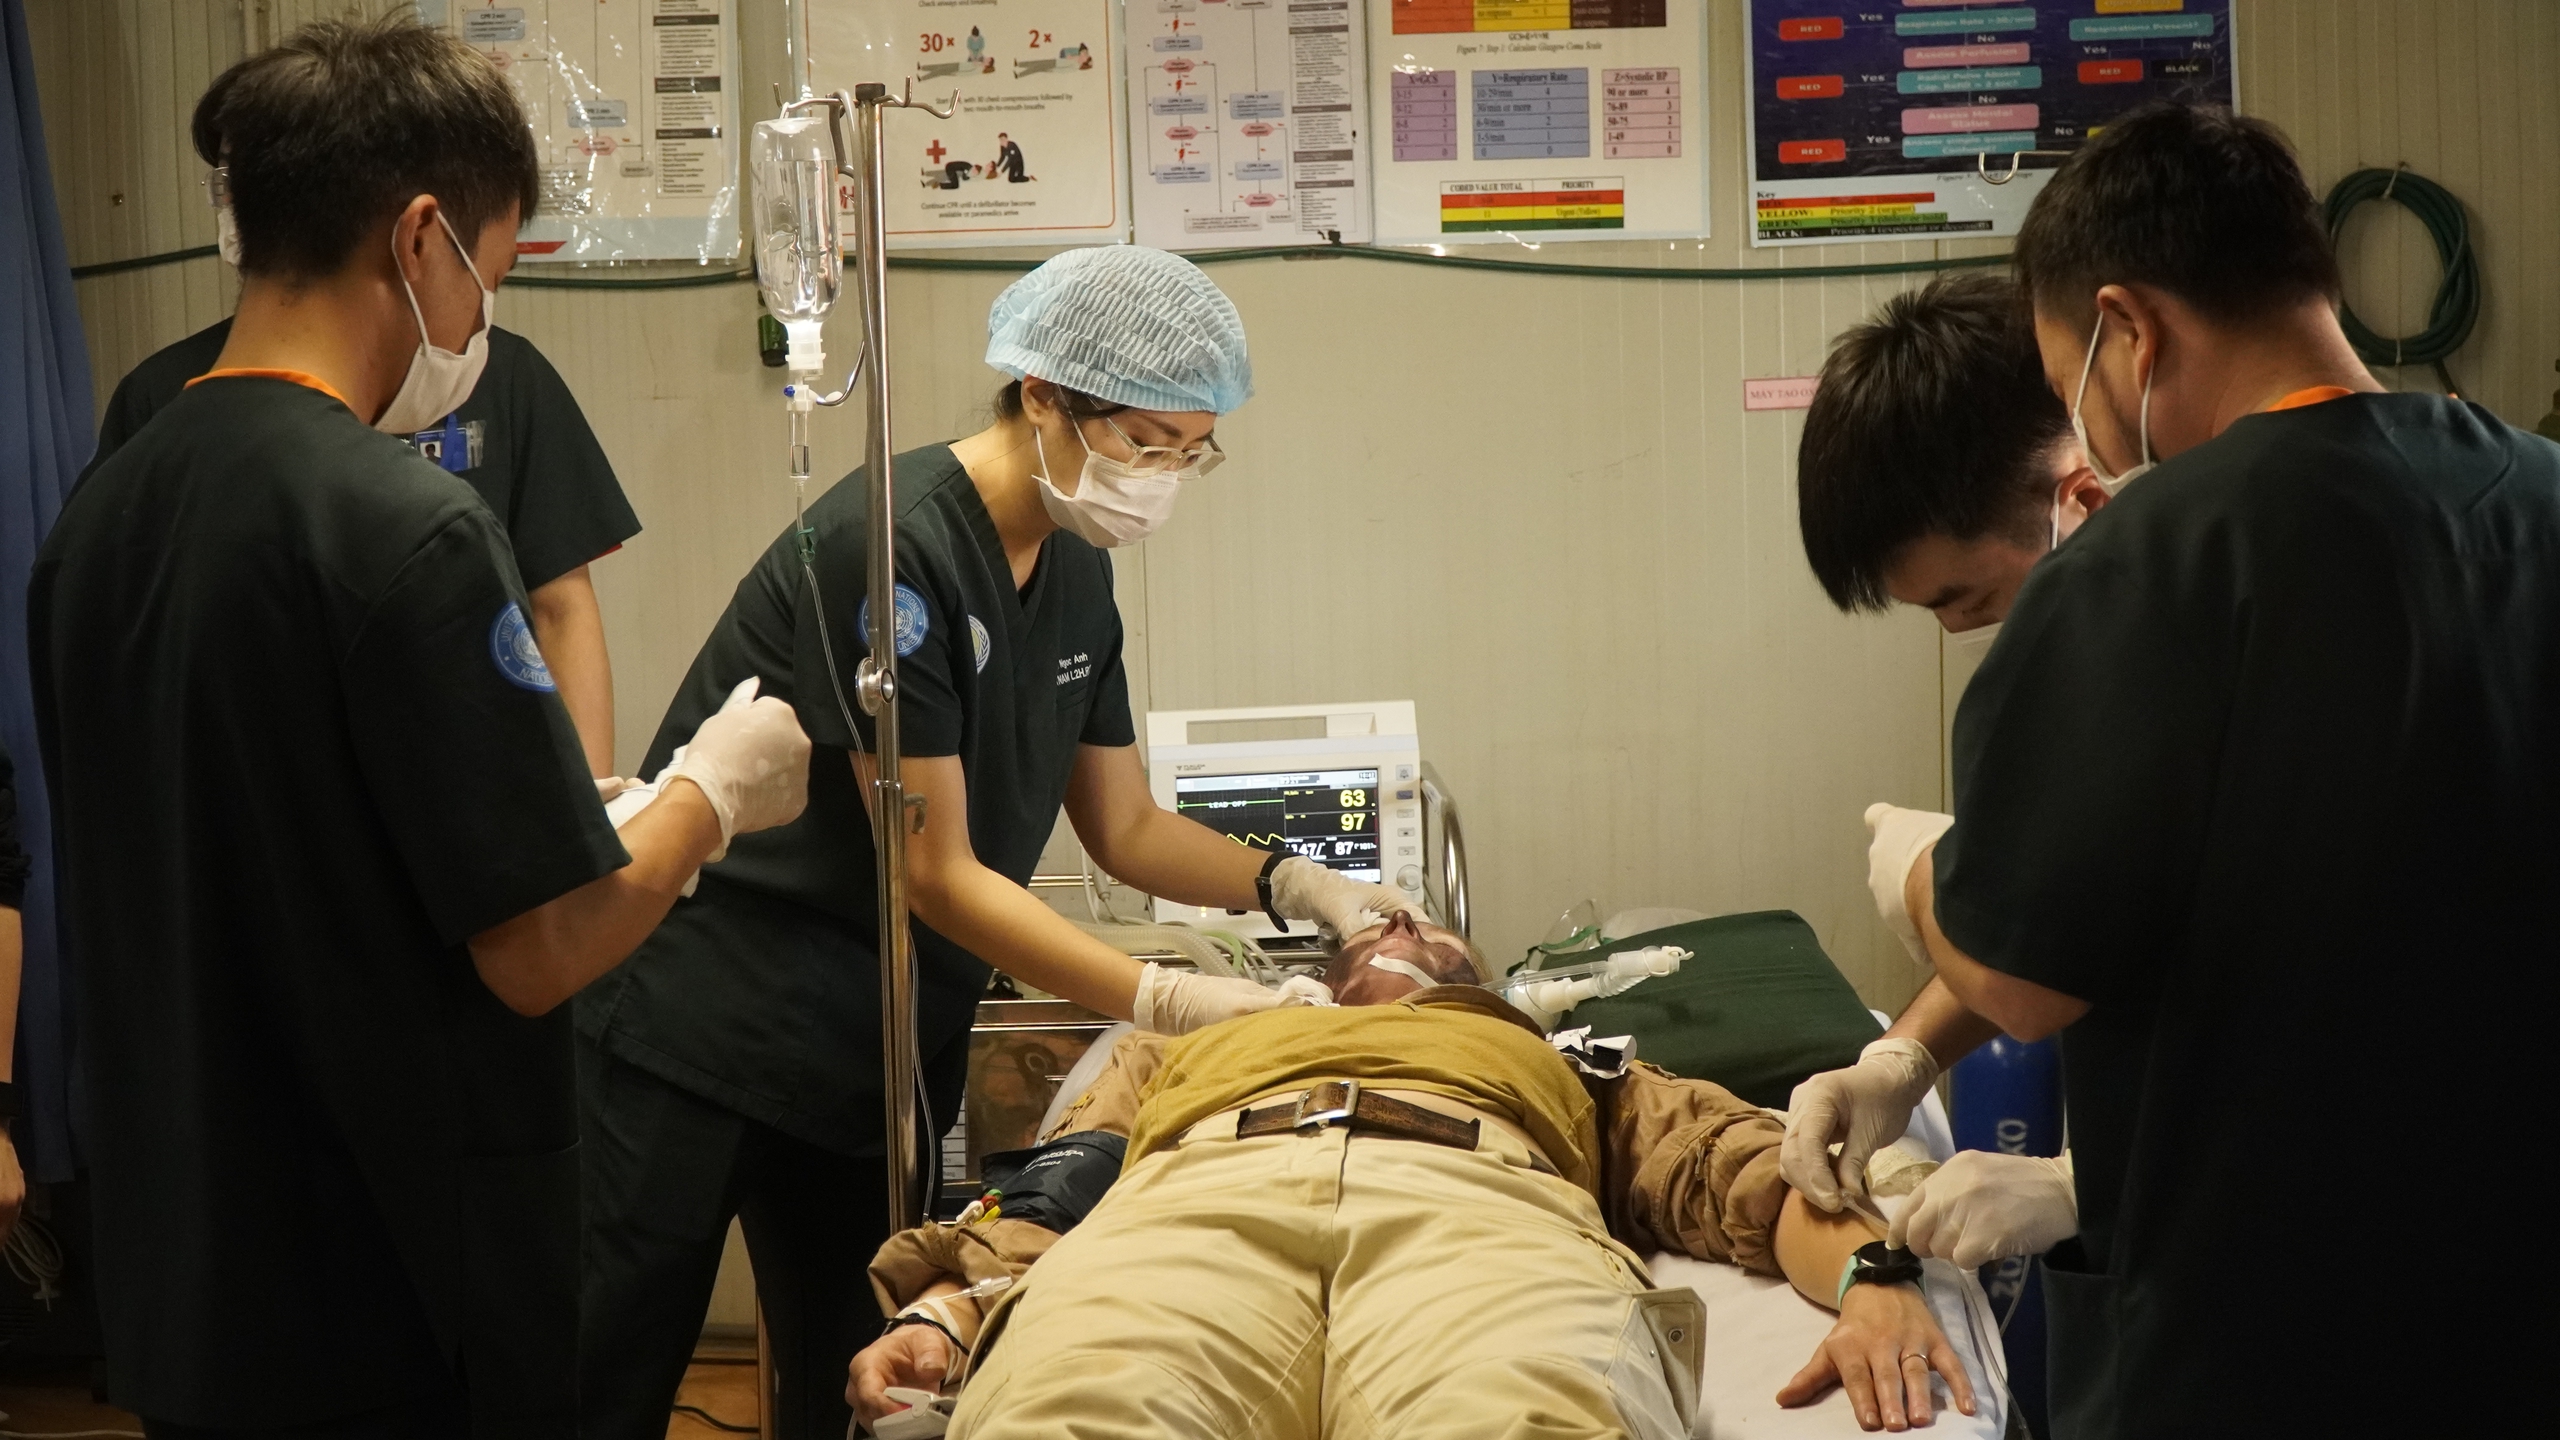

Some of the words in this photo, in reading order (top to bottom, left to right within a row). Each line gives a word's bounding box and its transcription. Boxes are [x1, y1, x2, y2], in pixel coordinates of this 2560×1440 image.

[1860, 14, 1884, 22] Yes
[1896, 20, 1957, 30] Respiration
[920, 33, 943, 52] 30
[1028, 29, 1040, 48] 2
[1977, 34, 1996, 42] No
[2082, 46, 2108, 54] Yes
[2192, 42, 2211, 50] No
[1916, 51, 1958, 59] Assess
[1960, 48, 2017, 57] Perfusion
[2165, 65, 2200, 73] BLACK
[1550, 72, 1568, 82] Rate
[1656, 72, 1668, 81] BP
[1916, 74, 1950, 82] Radial
[1978, 95, 1998, 104] No
[1927, 112, 1969, 120] Assess
[1972, 108, 2014, 117] Mental
[1951, 120, 1990, 128] Status
[2054, 127, 2074, 136] No
[1866, 136, 1891, 144] Yes
[1450, 184, 1474, 192] CODED
[1475, 183, 1499, 192] VALUE
[1501, 182, 1523, 191] TOTAL
[1561, 181, 1594, 189] PRIORITY
[1757, 192, 1776, 200] Key
[1758, 209, 1814, 218] YELLOW:
[1830, 208, 1865, 216] Priority
[1758, 230, 1802, 238] BLACK:
[1074, 652, 1088, 664] Anh
[1340, 789, 1366, 807] 63
[1209, 801, 1228, 809] LEAD
[1340, 813, 1366, 831] 97
[1335, 841, 1354, 856] 87
